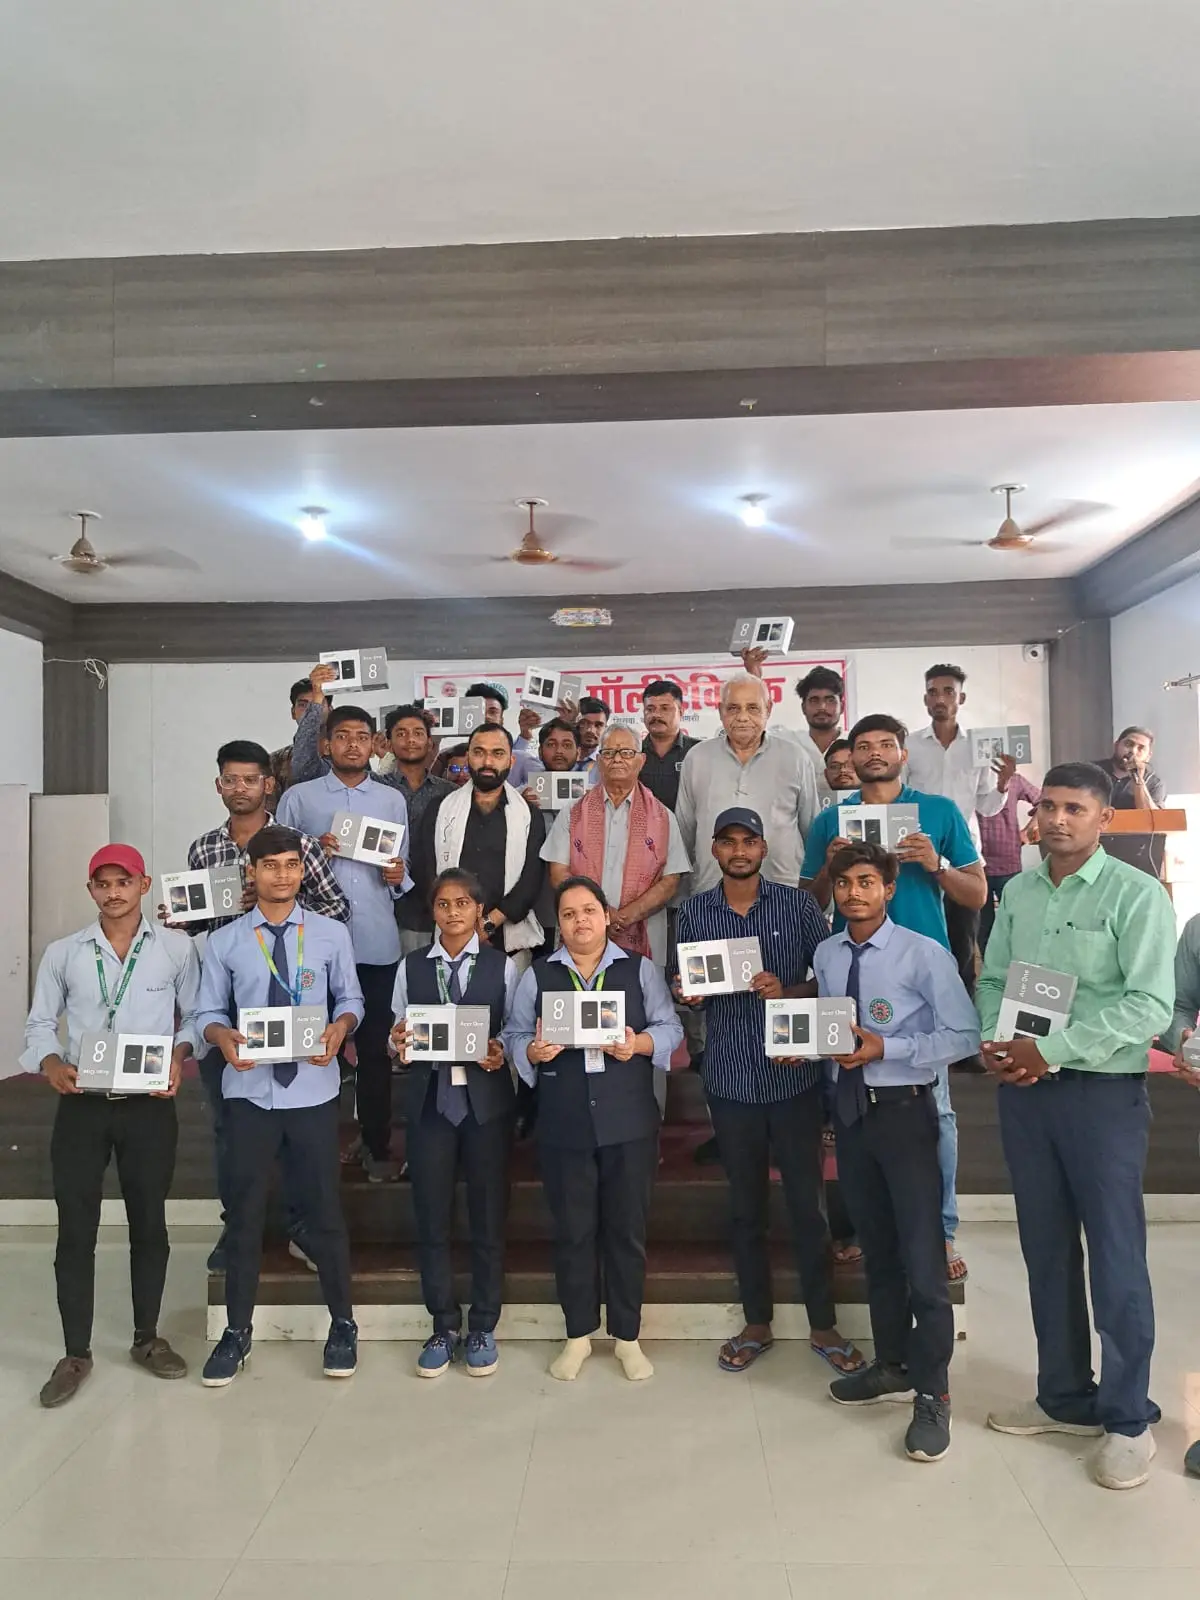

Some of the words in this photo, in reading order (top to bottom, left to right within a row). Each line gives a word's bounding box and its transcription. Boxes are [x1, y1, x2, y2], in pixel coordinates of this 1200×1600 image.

[740, 623, 749, 636] 8
[369, 664, 377, 679] 8
[465, 713, 474, 729] 8
[1016, 743, 1024, 759] 8
[536, 776, 545, 793] 8
[340, 818, 353, 837] 8
[222, 888, 233, 908] 8
[742, 960, 752, 982] 8
[1034, 982, 1061, 1000] 8
[553, 998, 565, 1020] 8
[302, 1027, 314, 1048] 8
[465, 1032, 476, 1054] 8
[827, 1022, 839, 1046] 8
[92, 1040, 107, 1062] 8
